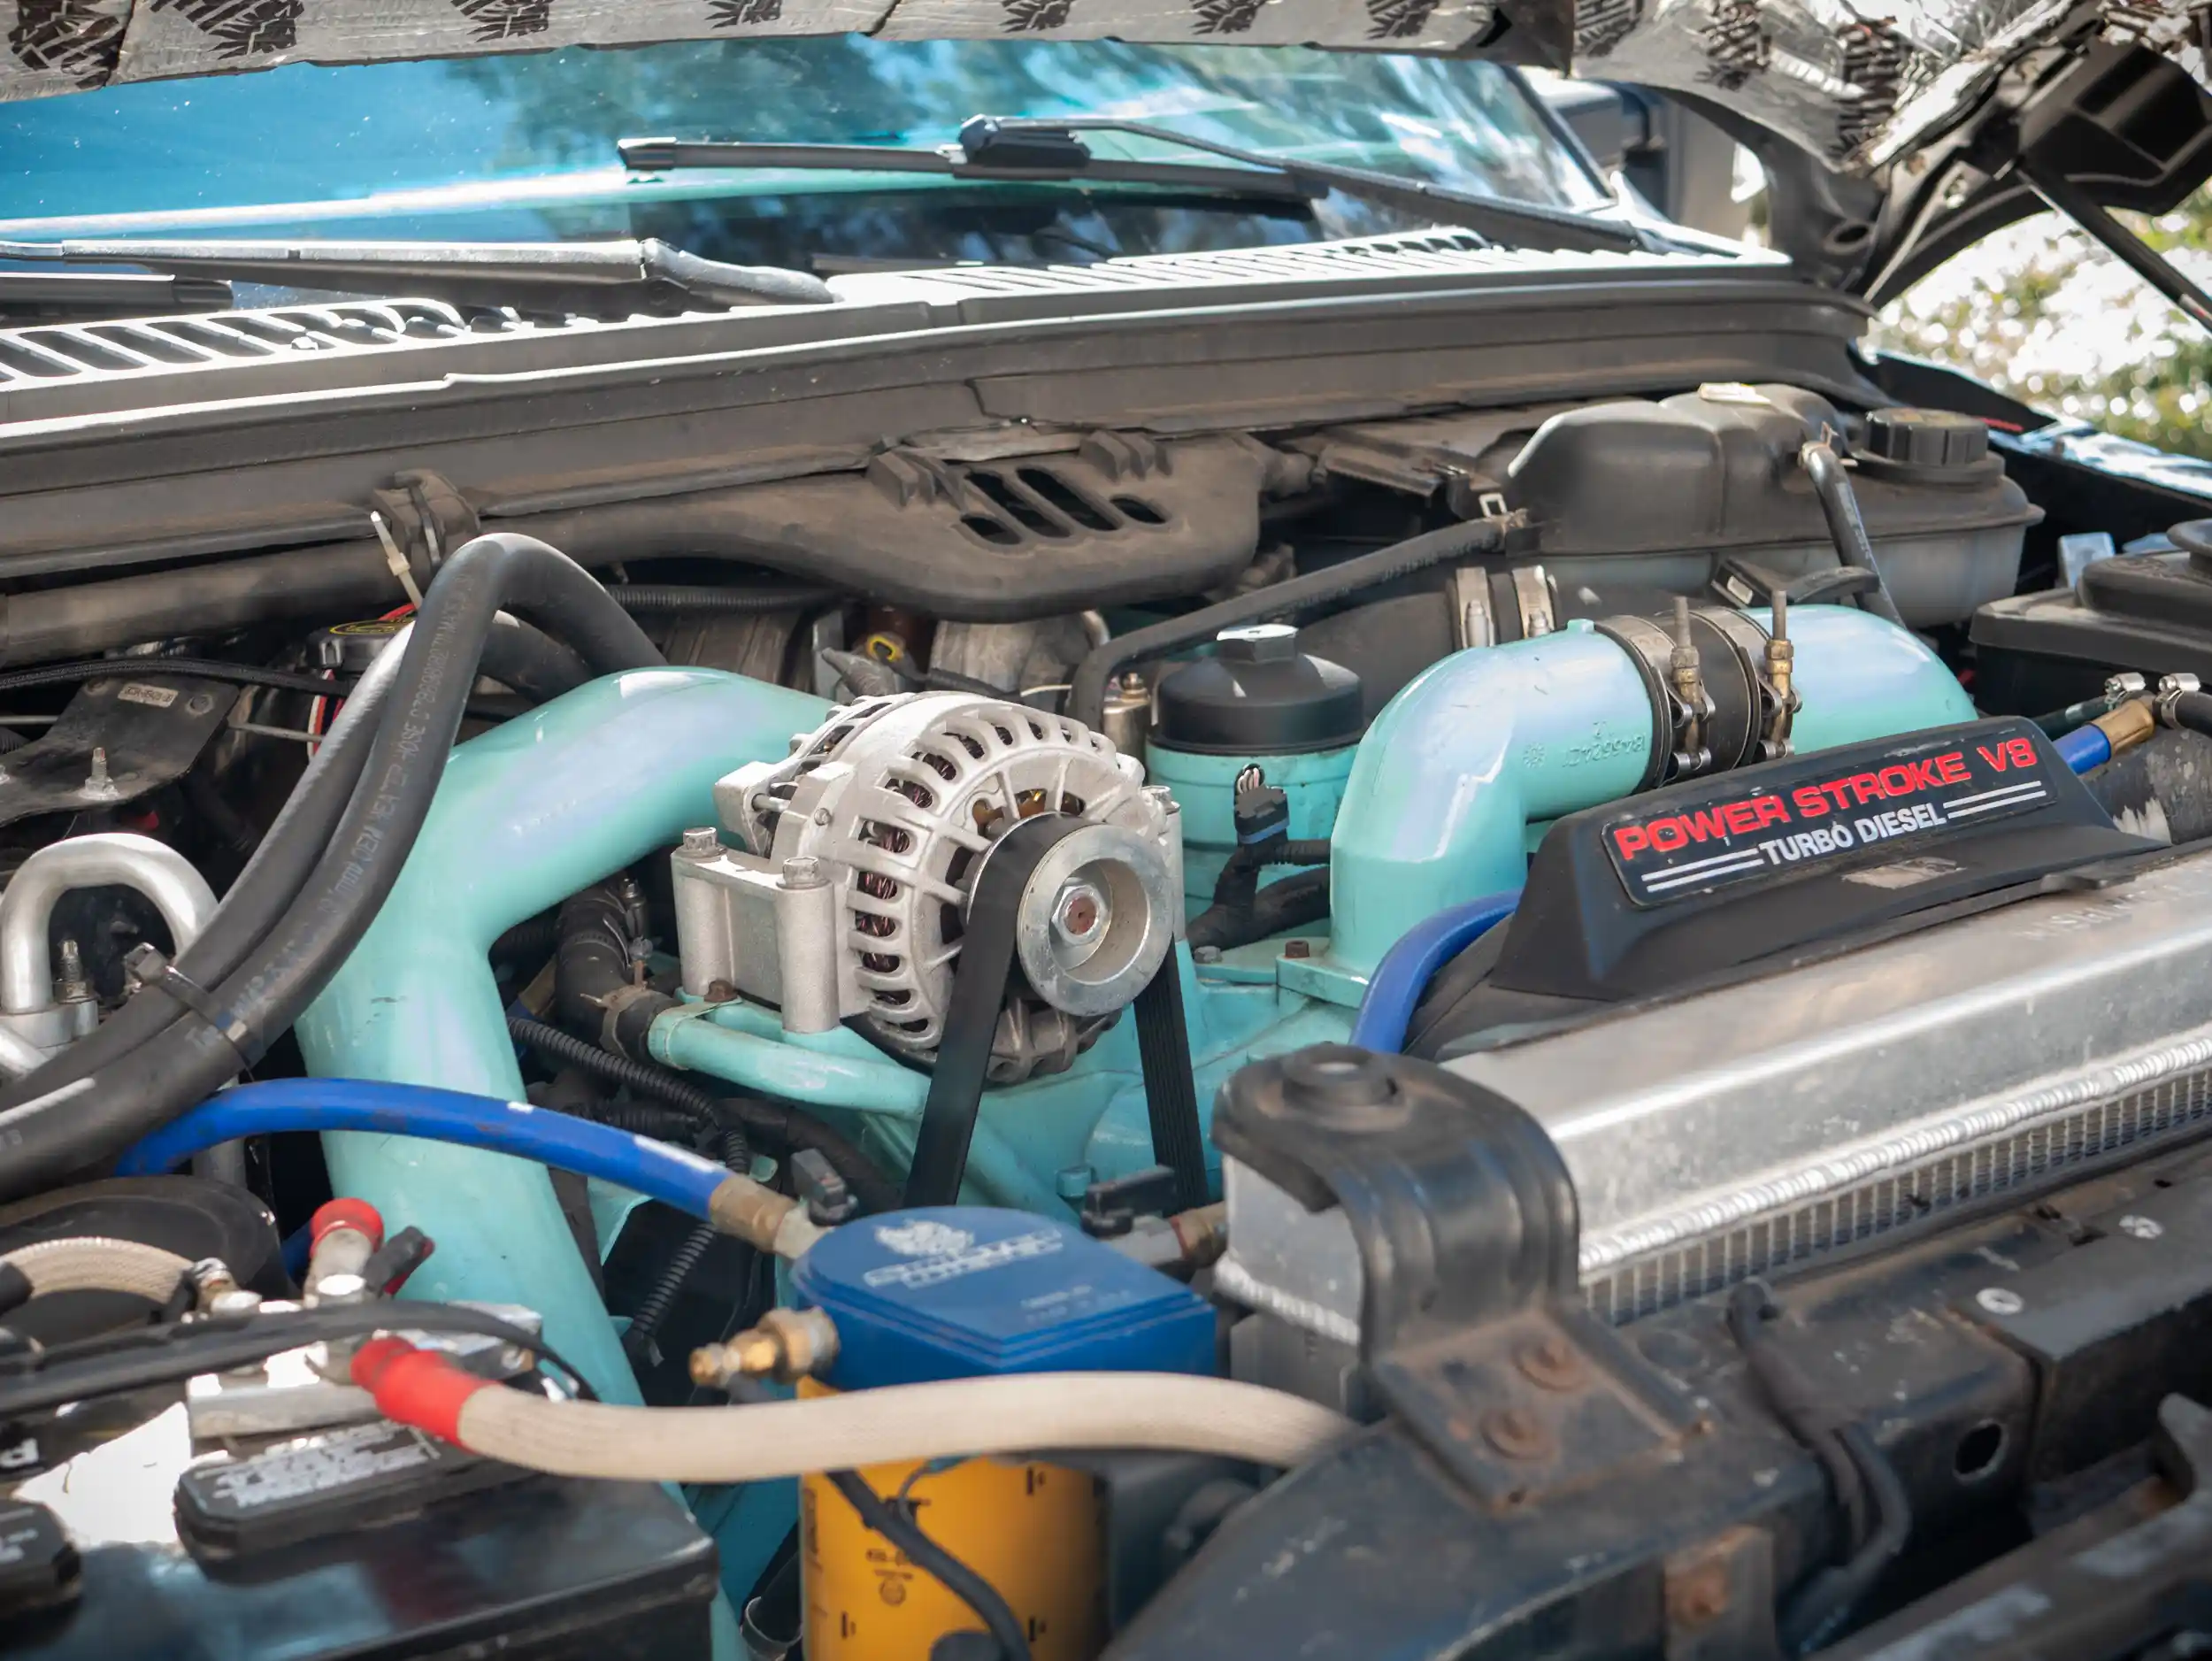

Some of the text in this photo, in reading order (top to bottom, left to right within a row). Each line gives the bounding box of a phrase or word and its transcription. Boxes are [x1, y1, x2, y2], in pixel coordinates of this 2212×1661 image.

[1615, 737, 2039, 861] POWER STROKE V8
[1758, 802, 1947, 865] TURBO DIESEL
